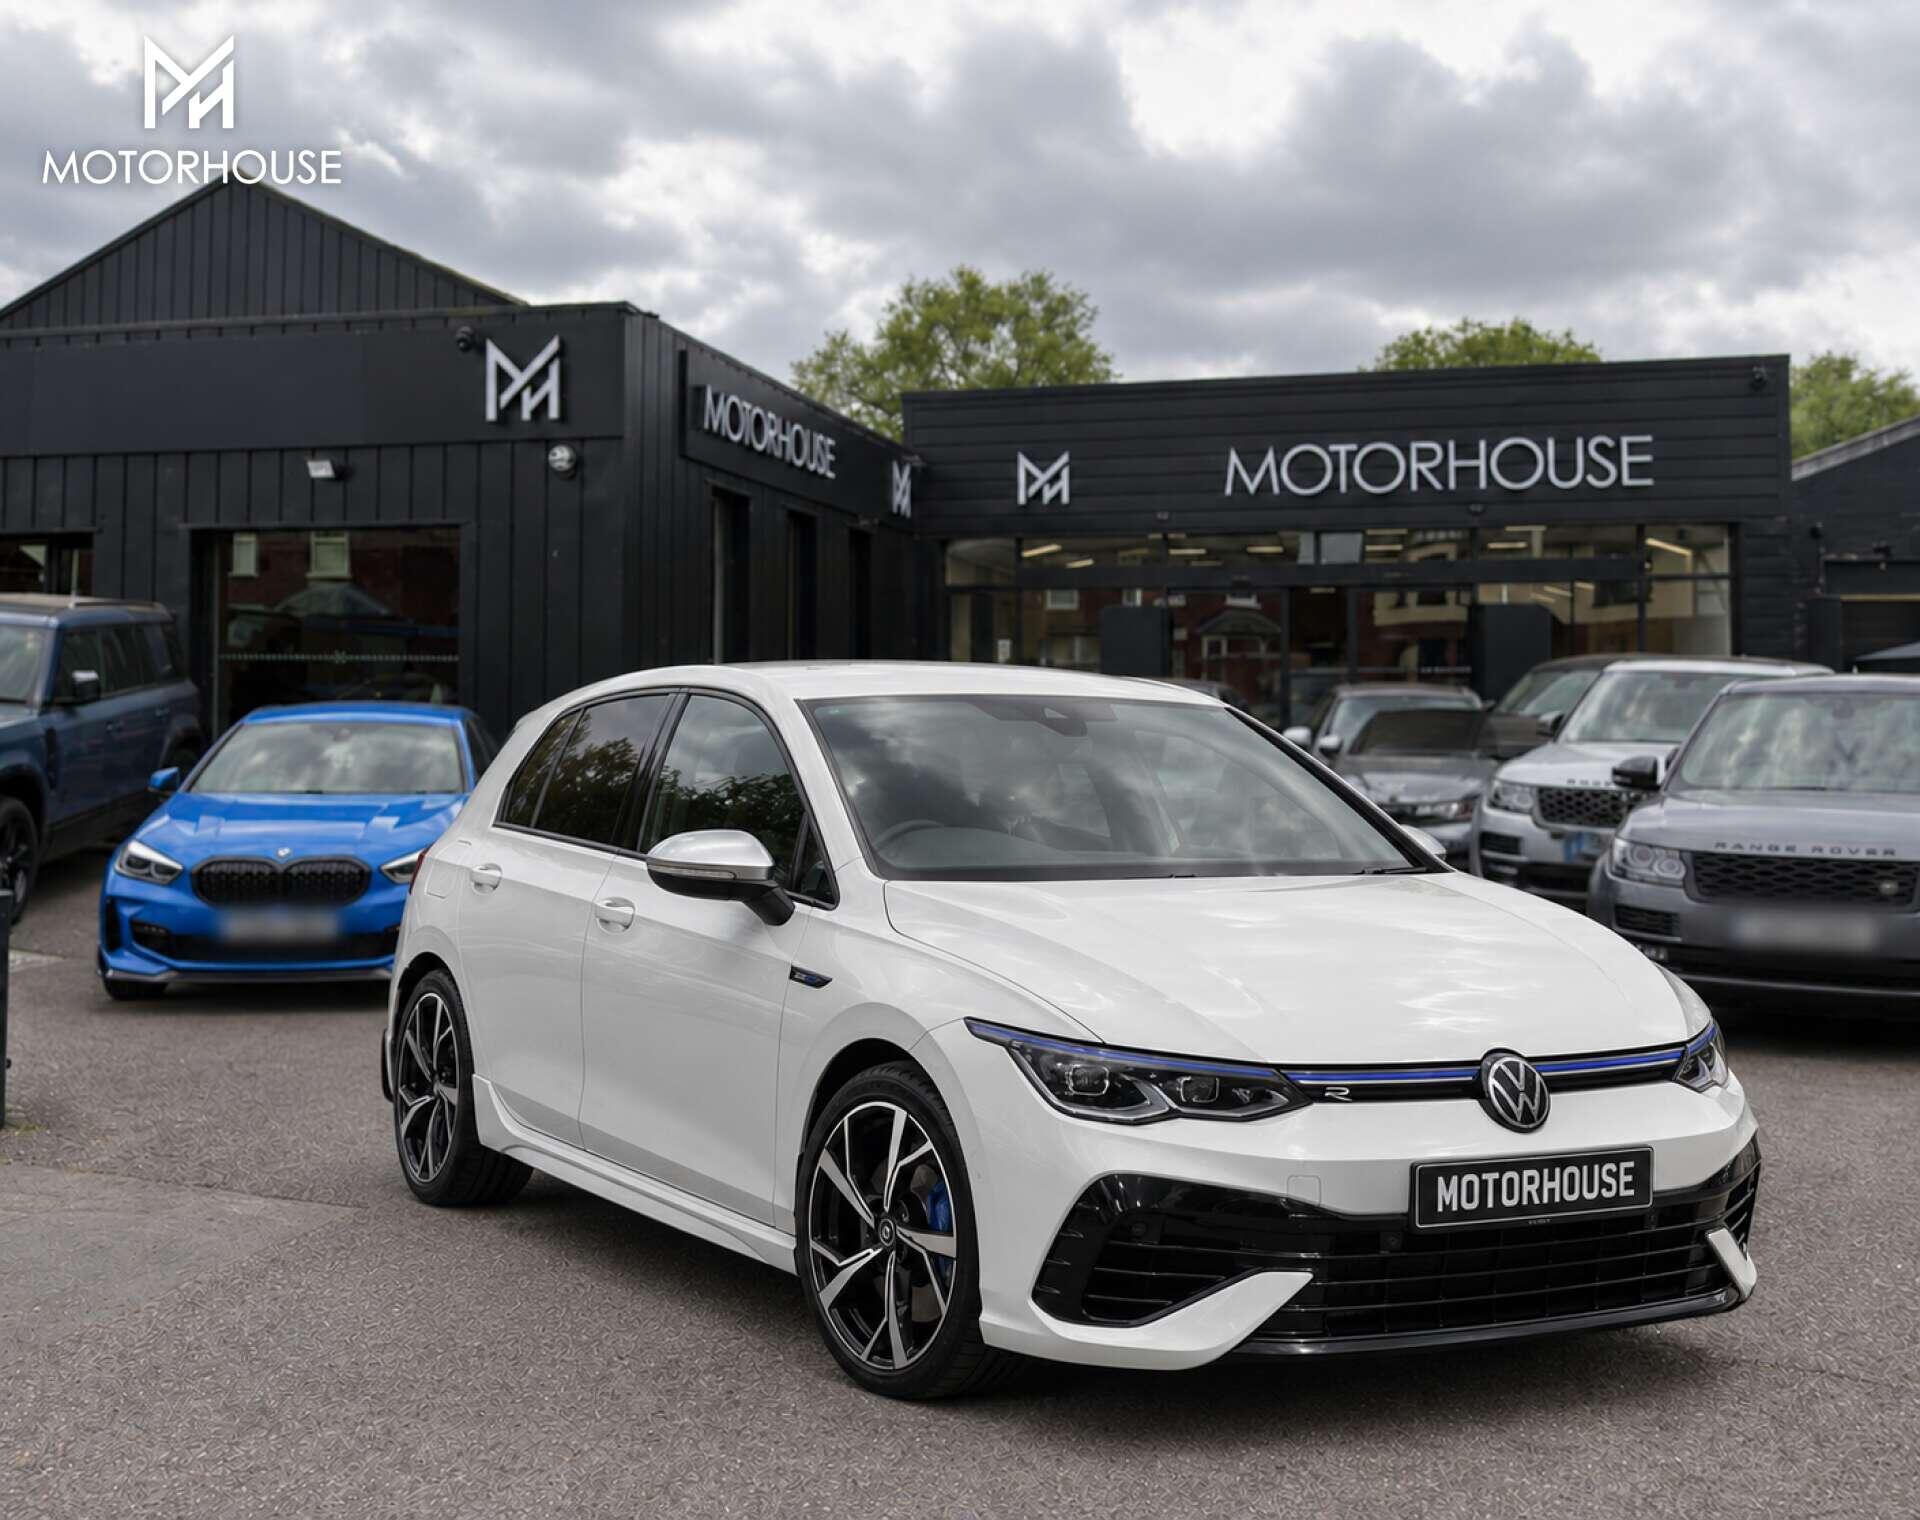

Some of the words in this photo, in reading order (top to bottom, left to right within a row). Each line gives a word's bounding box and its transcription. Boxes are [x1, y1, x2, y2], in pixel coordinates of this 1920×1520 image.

[703, 384, 837, 480] MOTORHOUSE
[1224, 434, 1655, 496] MOTORHOUSE
[1713, 841, 1798, 853] RANGE
[1810, 845, 1897, 857] ROVER
[1436, 1160, 1636, 1213] MOTORHOUSE
